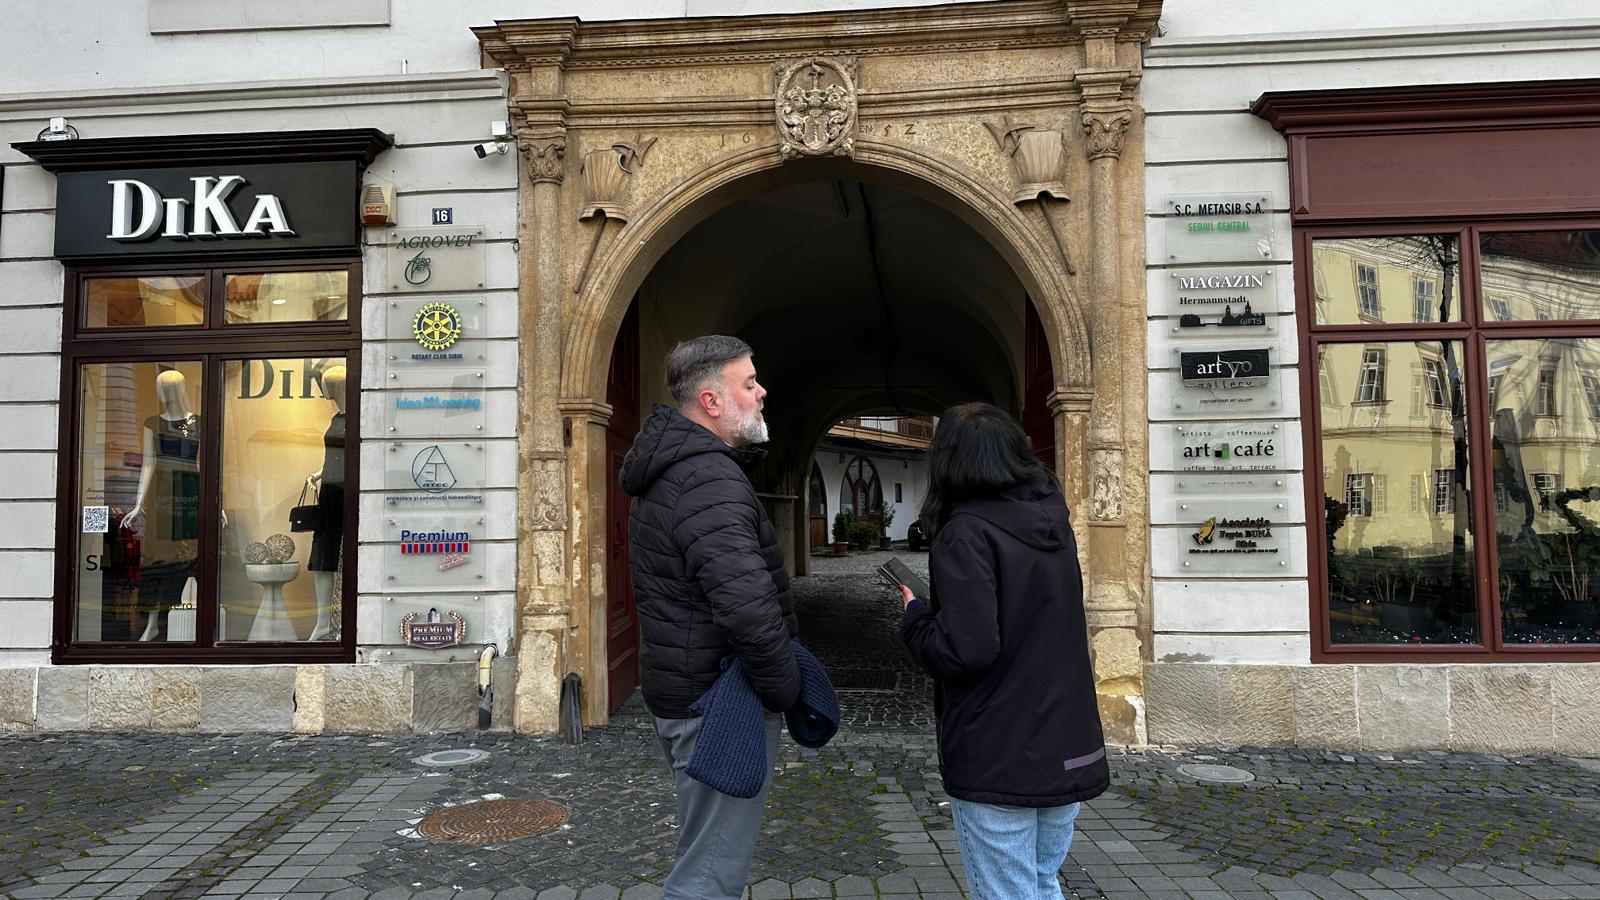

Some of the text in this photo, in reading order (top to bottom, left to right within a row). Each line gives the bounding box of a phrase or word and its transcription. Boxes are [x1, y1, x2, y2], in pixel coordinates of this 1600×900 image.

[1175, 202, 1265, 216] S.C. METASIB S.A.
[435, 210, 448, 222] 16
[1217, 221, 1250, 232] CENTRAL
[396, 234, 477, 249] AGROVET
[1179, 274, 1264, 289] MAGAZIN
[1180, 295, 1247, 305] Hermannstadt
[1183, 439, 1274, 458] art café
[401, 529, 469, 541] Premium
[413, 625, 453, 634] PREMIUM
